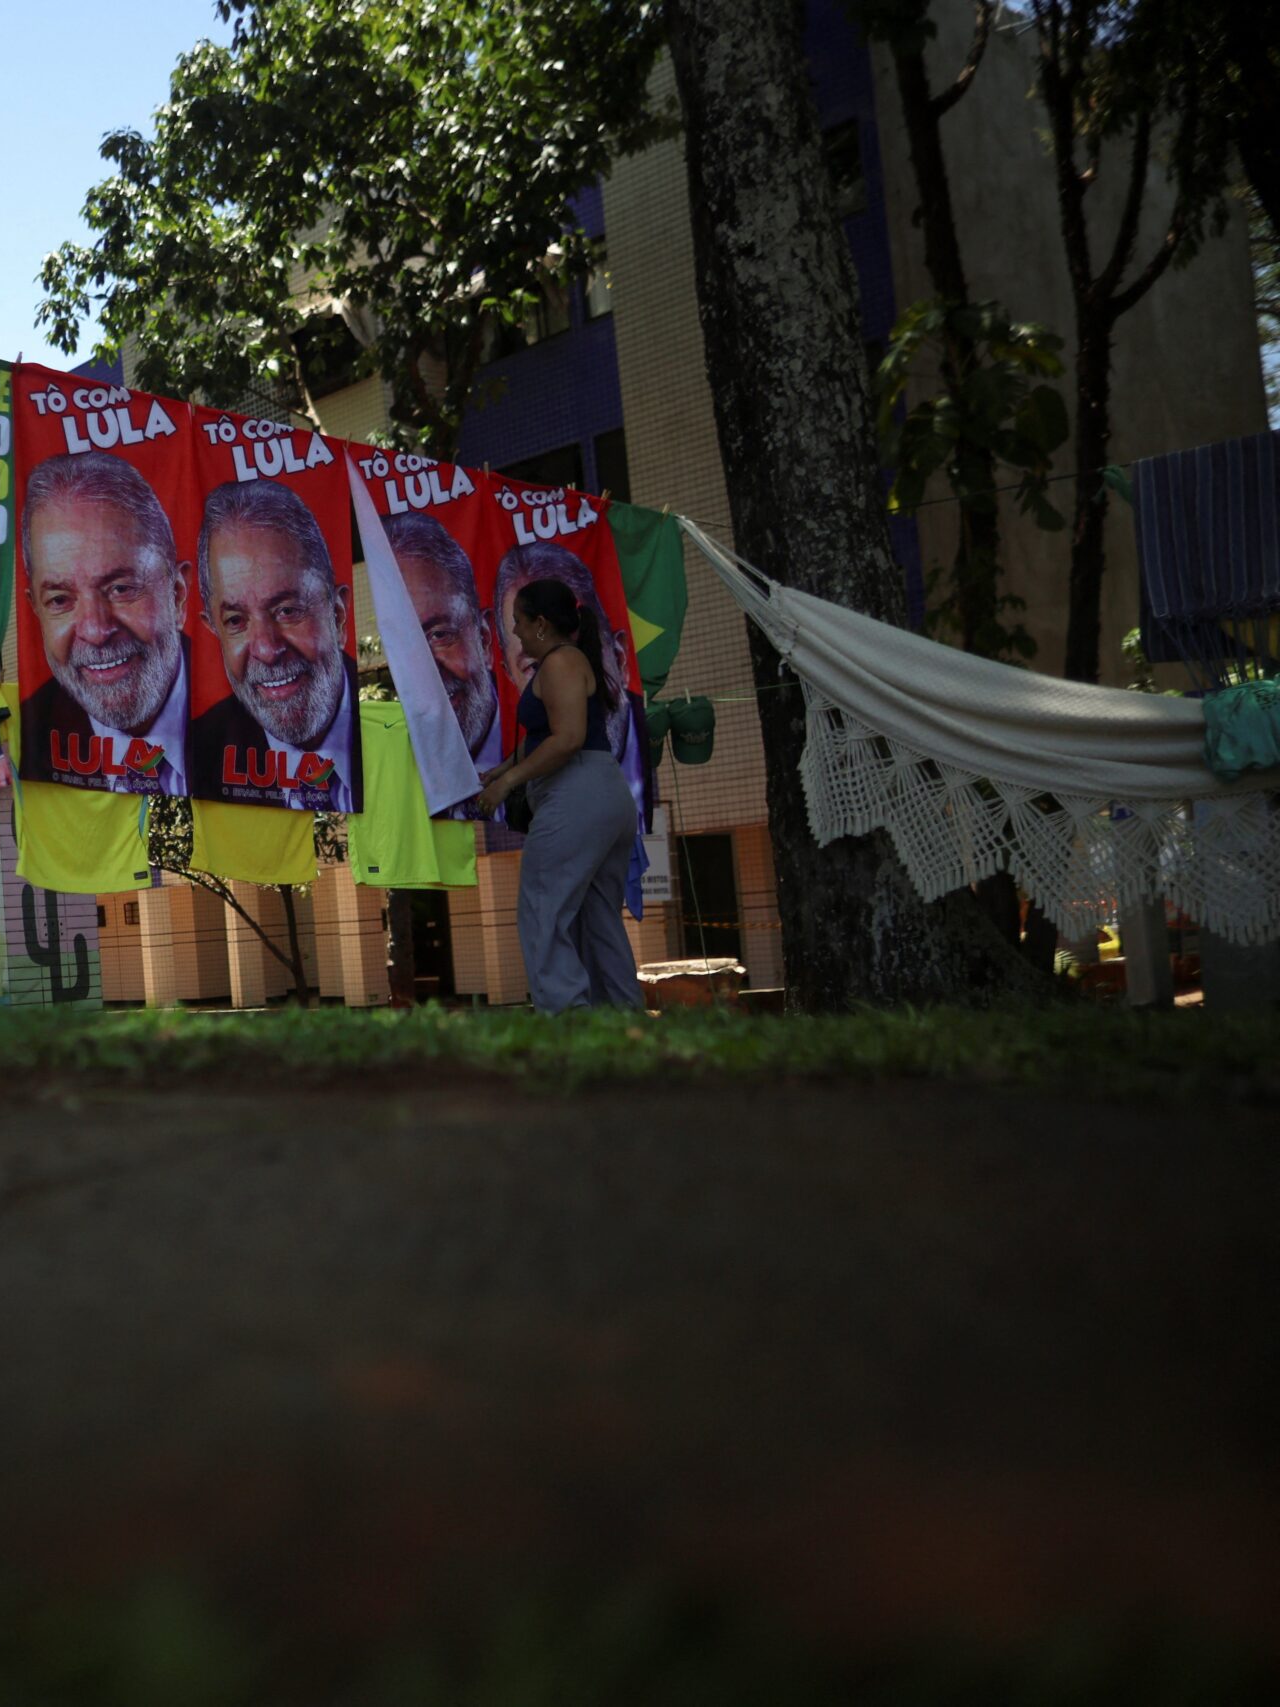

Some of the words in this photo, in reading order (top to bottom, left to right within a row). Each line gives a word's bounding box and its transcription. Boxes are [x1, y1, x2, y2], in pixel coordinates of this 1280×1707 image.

[30, 383, 67, 415] TÔ
[73, 385, 132, 410] COM
[62, 399, 177, 455] LULA
[203, 414, 237, 445] TÔ
[232, 432, 334, 483] LULA
[359, 450, 389, 480] TÔ
[384, 465, 475, 515] LULA
[512, 497, 598, 546] LULA
[50, 729, 165, 778] LULA
[222, 744, 335, 790] LULA
